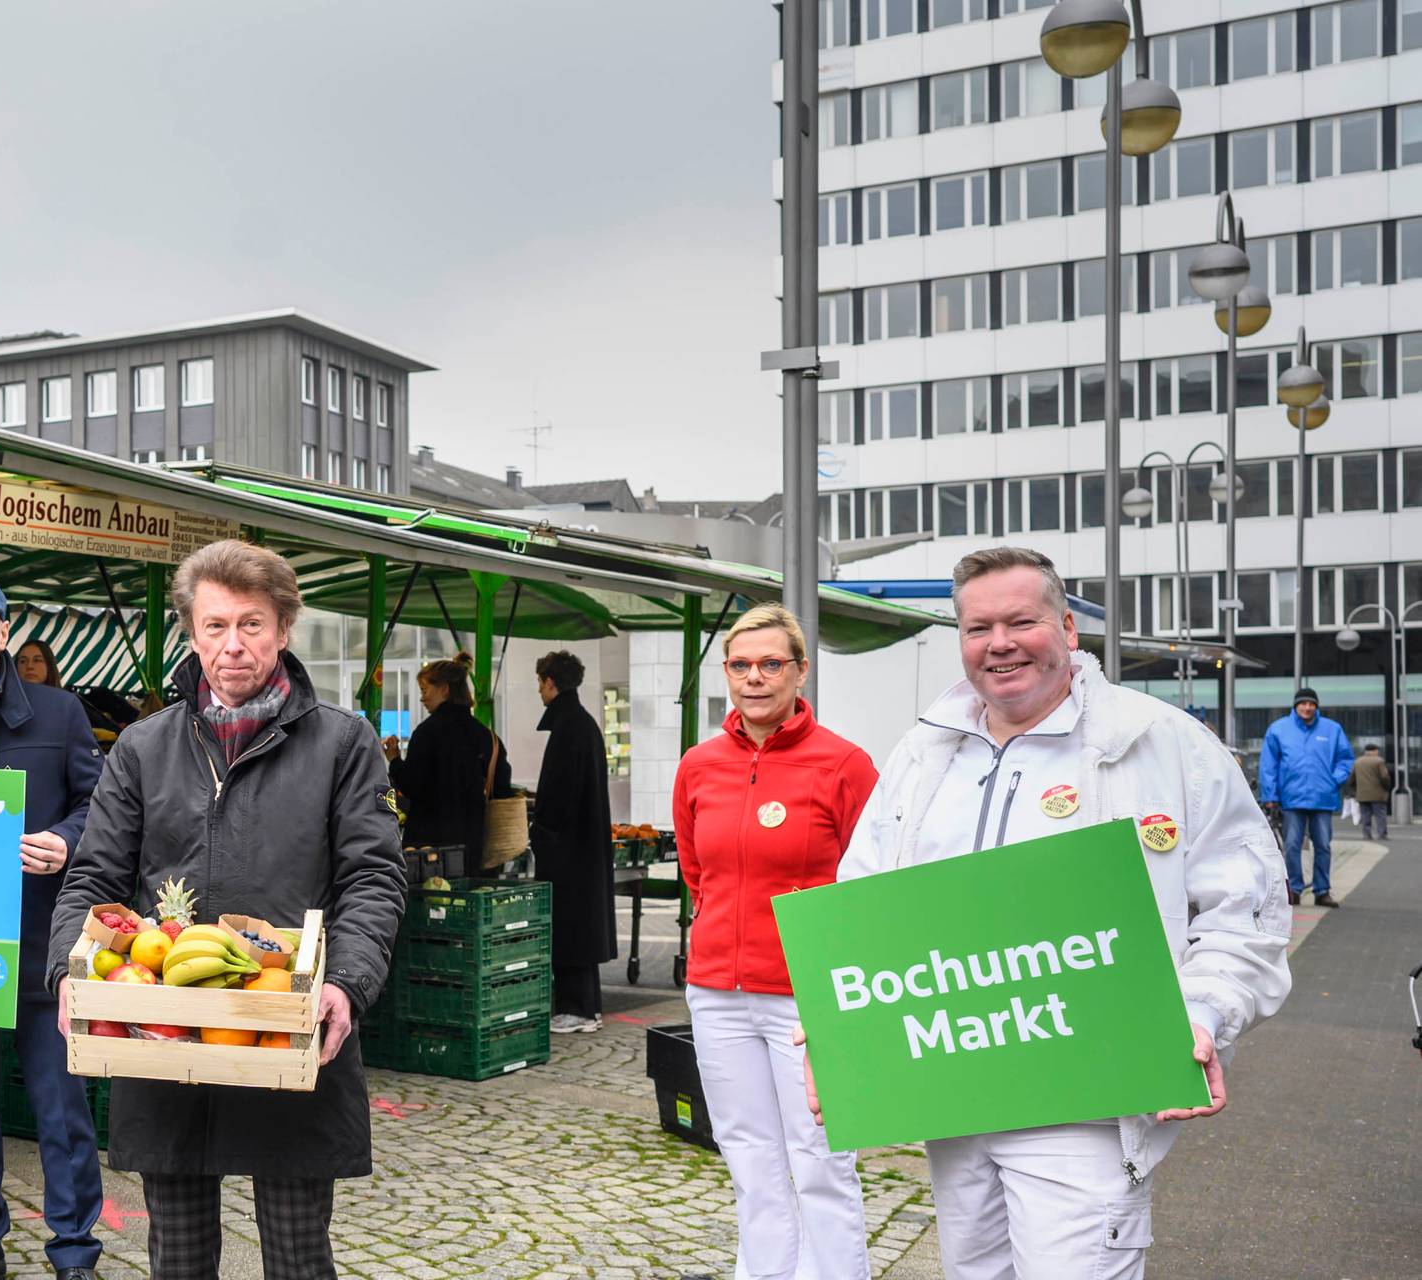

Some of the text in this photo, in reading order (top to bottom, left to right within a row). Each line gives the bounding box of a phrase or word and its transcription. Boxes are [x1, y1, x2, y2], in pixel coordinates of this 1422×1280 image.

[11, 531, 28, 543] aus
[31, 530, 85, 551] biologischer
[86, 537, 131, 558] Erzeugung
[134, 545, 168, 560] weltweit
[107, 501, 170, 538] Anbau
[830, 927, 1119, 1012] Bochumer
[902, 992, 1075, 1060] Markt
